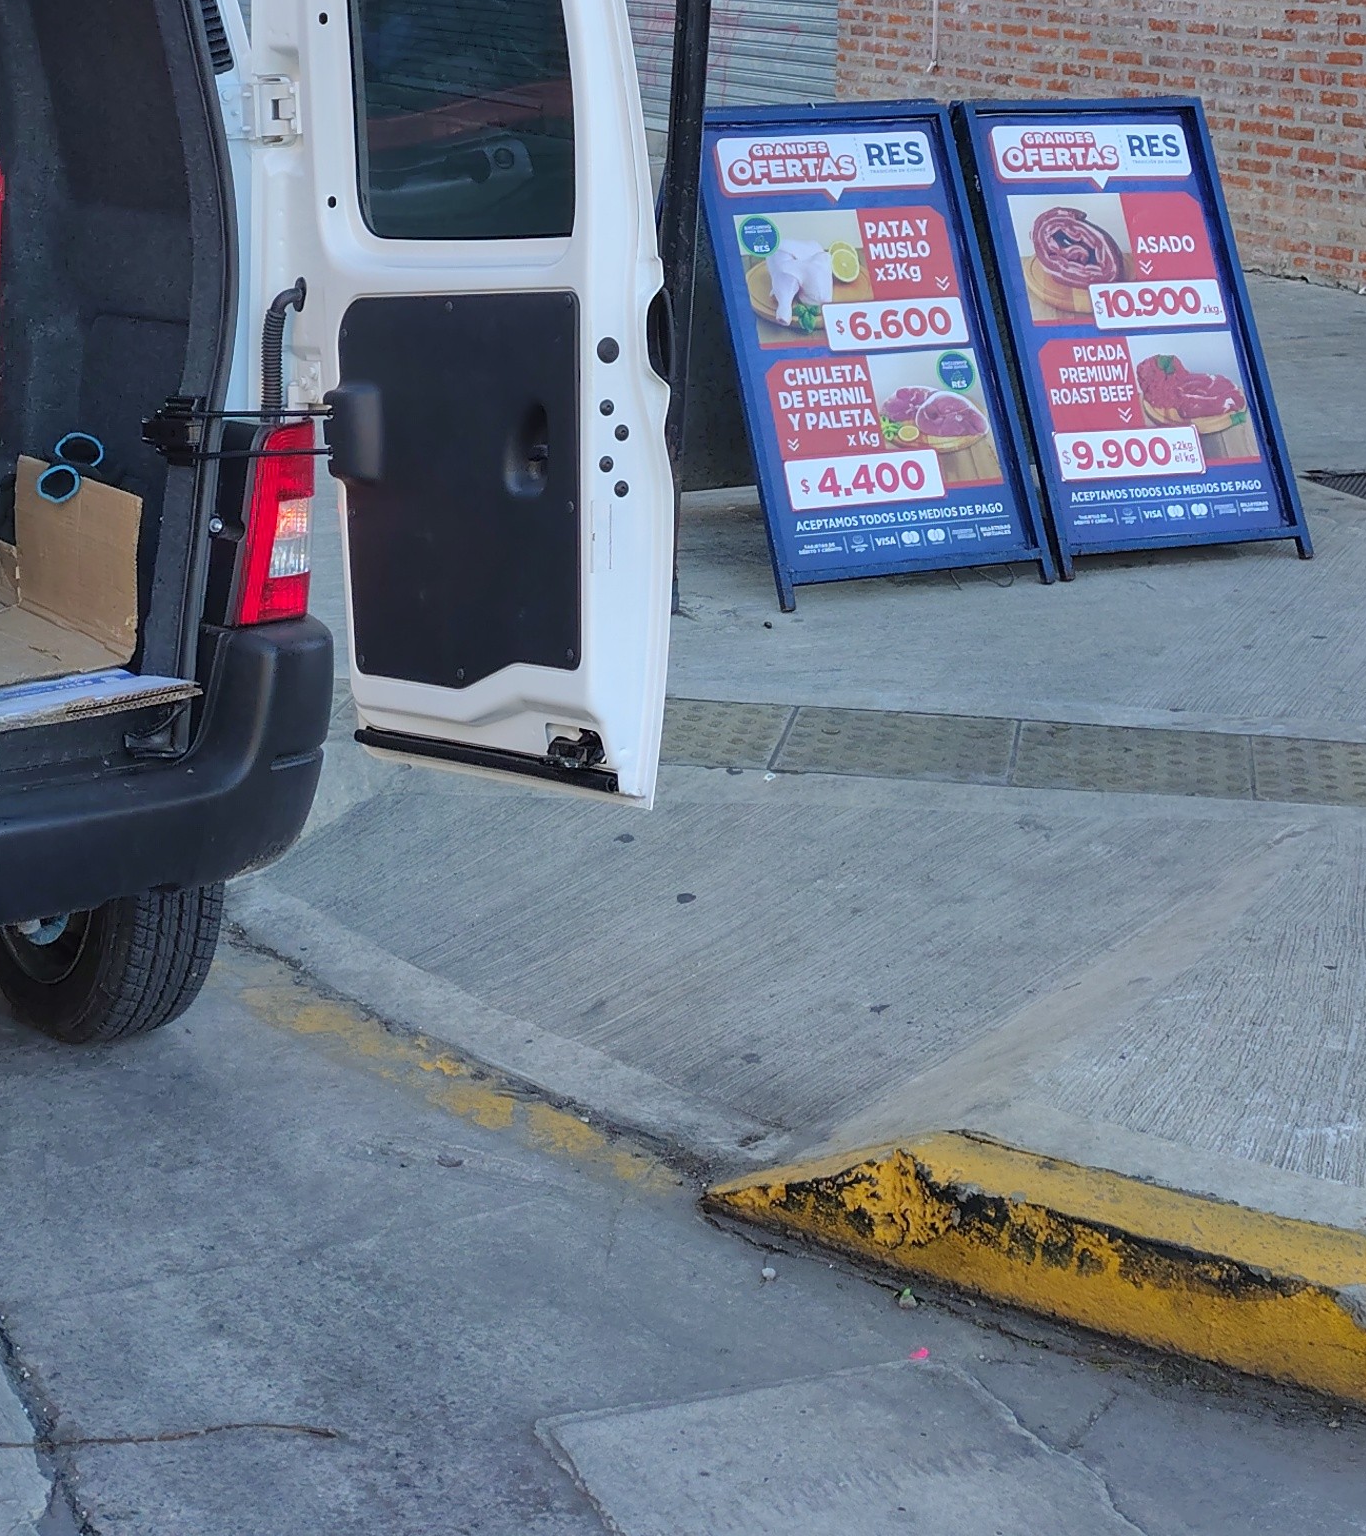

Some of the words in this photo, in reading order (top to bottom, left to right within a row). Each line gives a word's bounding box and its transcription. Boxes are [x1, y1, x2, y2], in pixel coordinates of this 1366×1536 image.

[1024, 132, 1094, 145] GRANDES
[1126, 133, 1181, 157] RES
[752, 142, 829, 157] GRANDES
[864, 141, 924, 166] RES
[1006, 146, 1119, 168] OFERTAS
[733, 155, 856, 181] OFERTAS
[864, 220, 912, 240] PATA
[913, 219, 929, 236] Y
[868, 239, 930, 261] MUSLO
[1137, 235, 1195, 254] ASADO
[875, 262, 922, 283] x3Kg
[1072, 344, 1127, 363] PICADA
[783, 365, 868, 387] CHULETA
[778, 390, 805, 410] DE
[808, 386, 872, 408] PERNIL
[1050, 386, 1096, 405] ROAST
[1100, 384, 1134, 402] BEEF
[788, 414, 801, 431] Y
[806, 408, 877, 430] PALETA
[847, 434, 856, 446] x
[858, 430, 880, 447] Kg
[1071, 490, 1129, 503] ACEPTAMOS
[1129, 488, 1161, 499] TODOS
[1163, 486, 1182, 496] LOS
[1183, 483, 1219, 495] MEDIOS
[1220, 481, 1234, 491] DE
[1235, 479, 1262, 490] PAGO
[796, 516, 859, 532] ACEPTAMOS
[859, 512, 895, 525] TODOS
[897, 511, 917, 523] LOS
[919, 507, 958, 521] MEDIOS
[959, 505, 974, 516] DE
[975, 502, 1003, 515] PAGO
[1143, 509, 1163, 519] VISA
[875, 537, 896, 547] VISA
